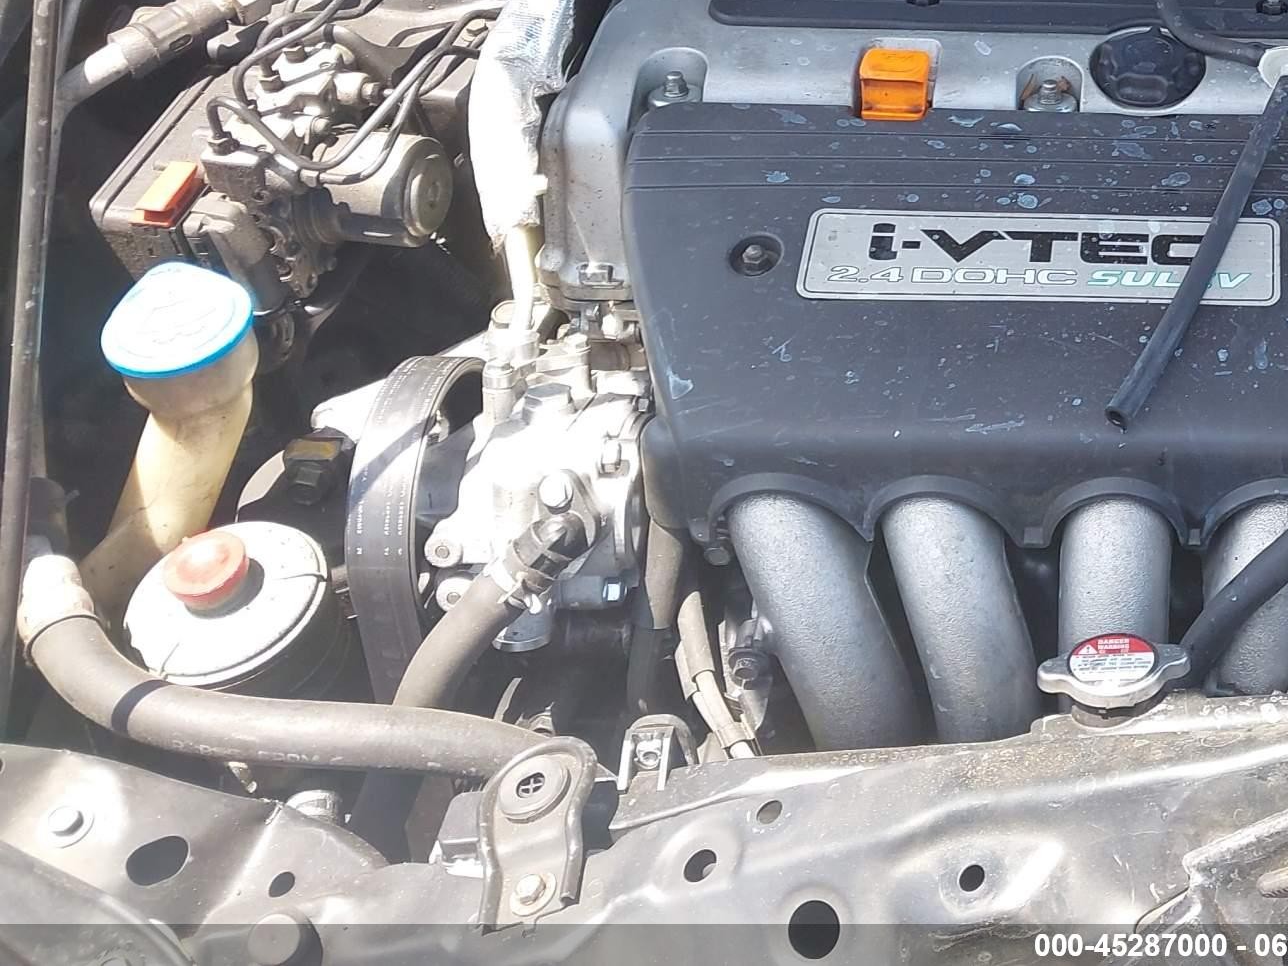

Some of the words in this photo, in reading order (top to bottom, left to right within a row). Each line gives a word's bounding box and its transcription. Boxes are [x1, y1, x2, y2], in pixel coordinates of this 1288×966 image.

[869, 223, 1204, 266] i-VTEC
[827, 265, 904, 284] 2.4
[911, 266, 1088, 285] DOHC
[1088, 270, 1251, 290] SULV
